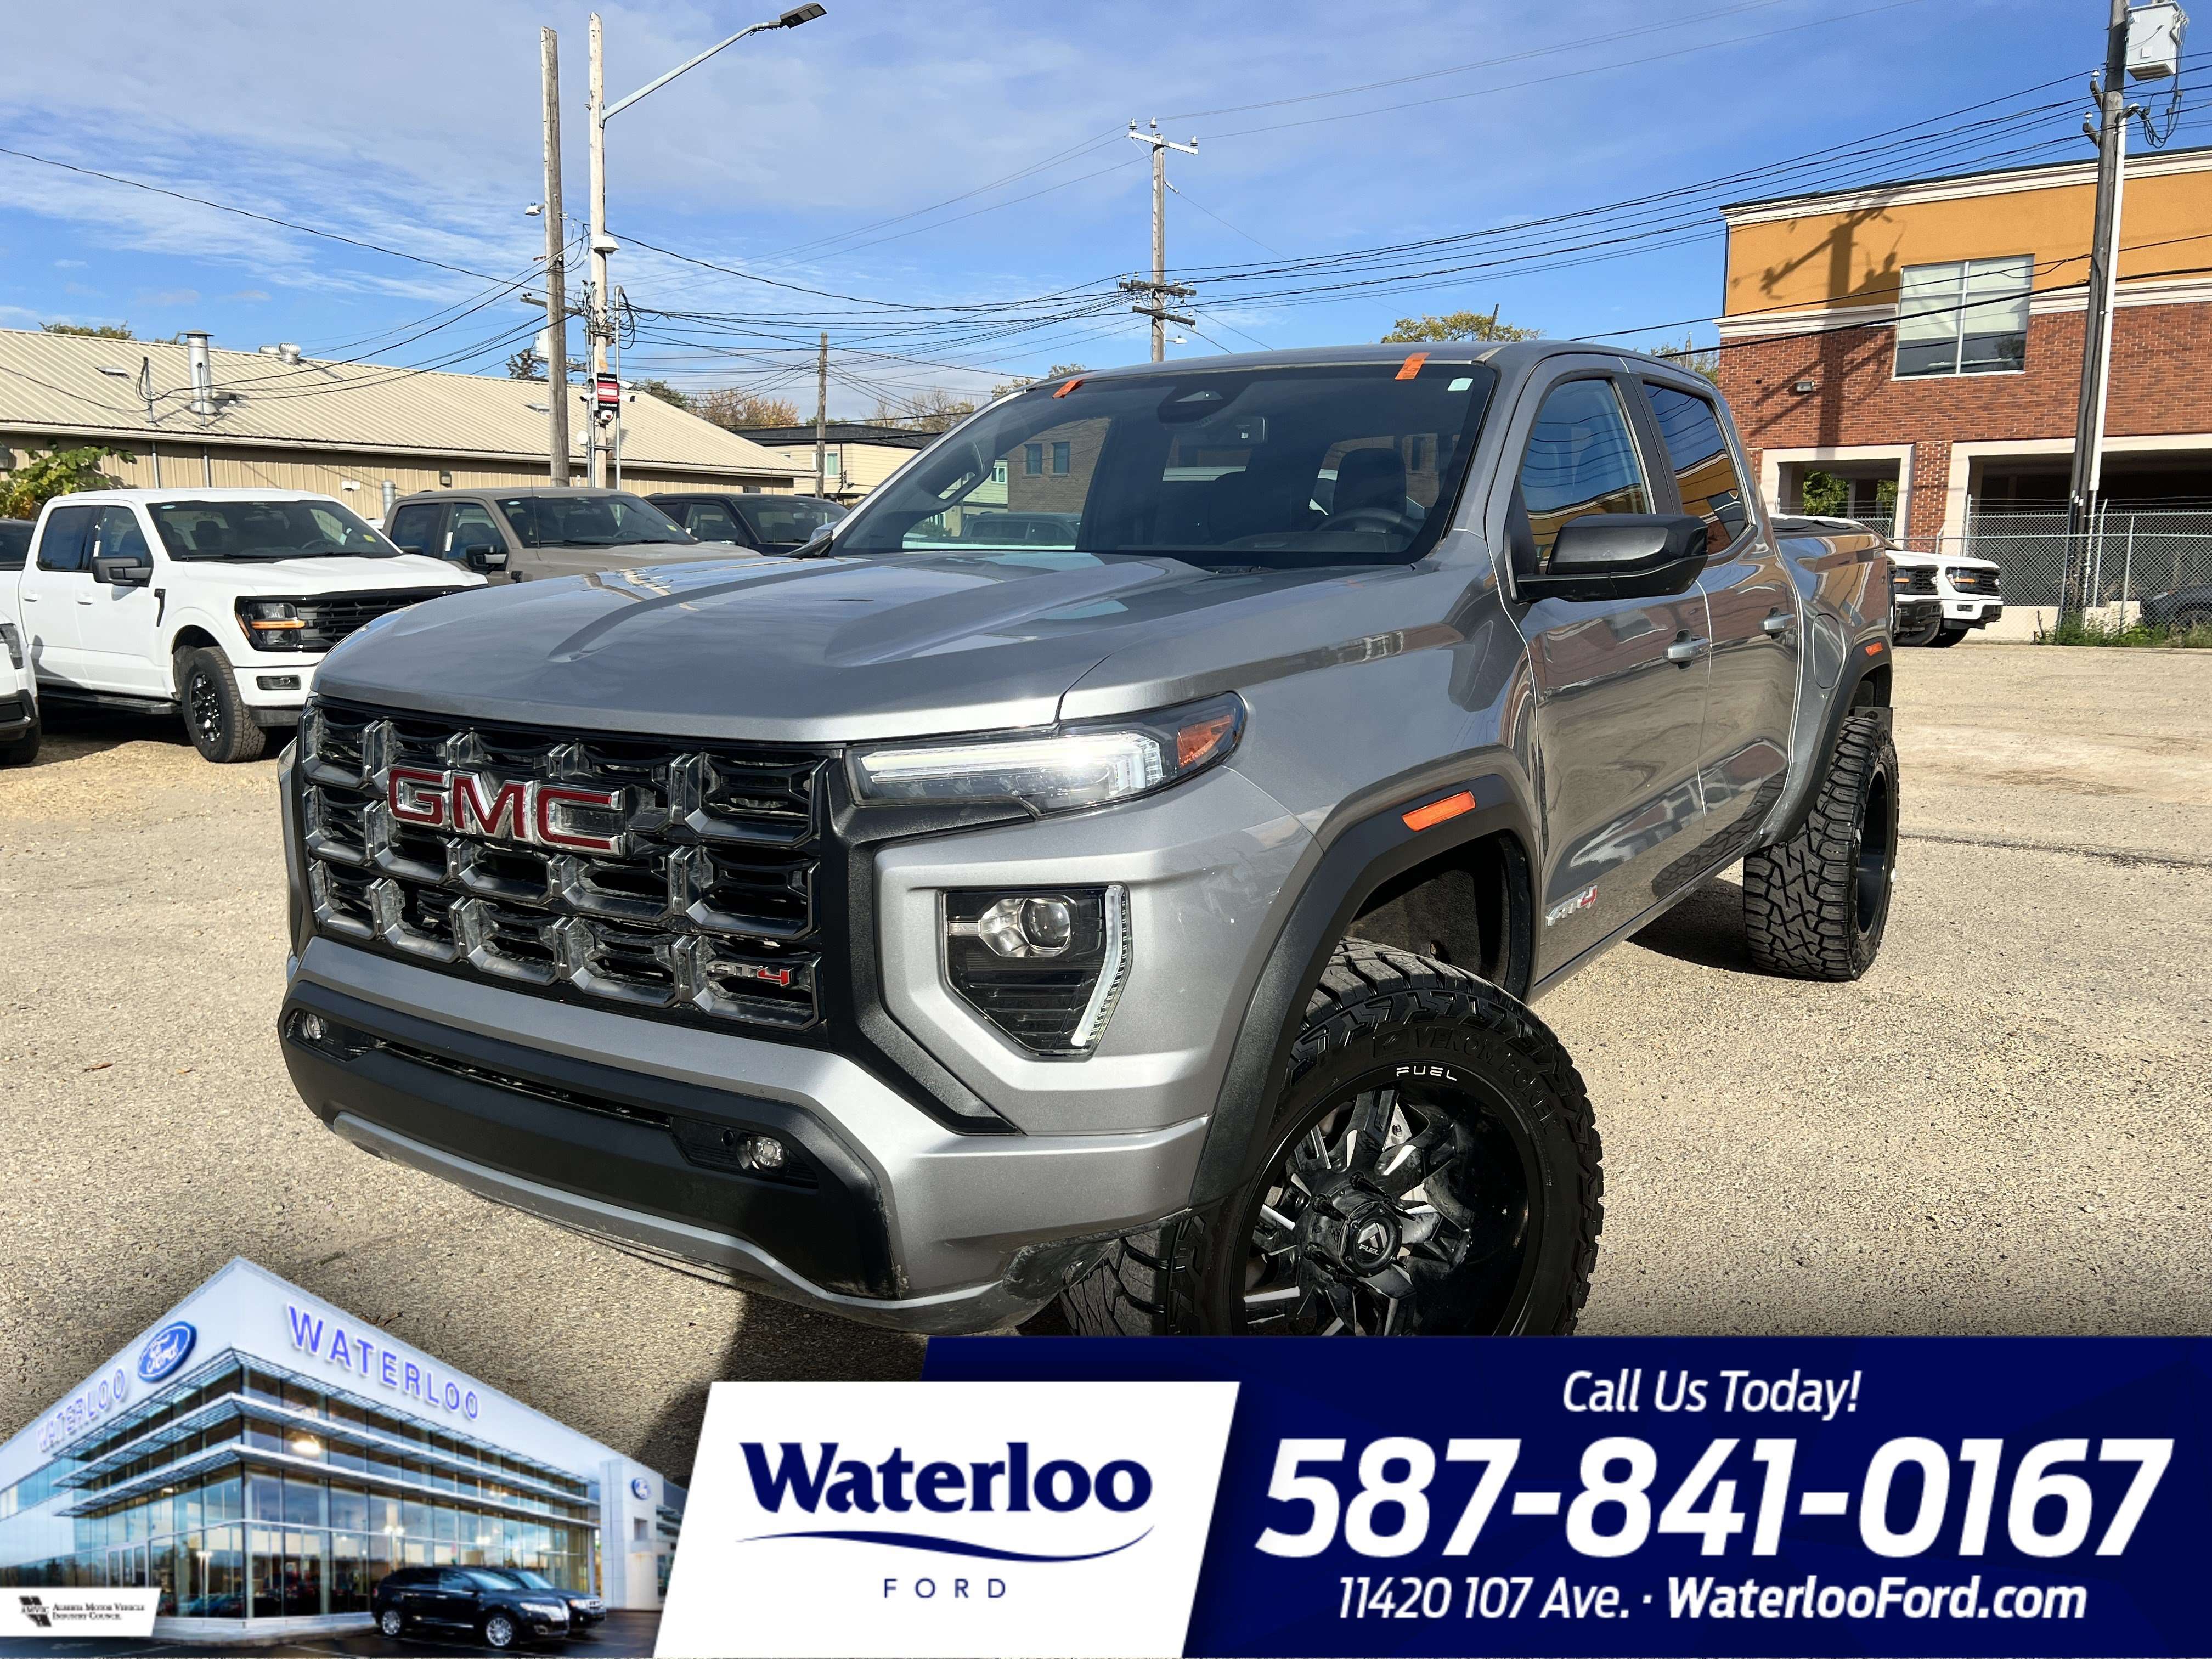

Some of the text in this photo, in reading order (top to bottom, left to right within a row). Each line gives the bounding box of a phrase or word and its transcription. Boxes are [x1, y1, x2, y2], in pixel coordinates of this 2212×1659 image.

[387, 768, 624, 856] GMC
[706, 960, 791, 987] AT4
[1396, 1065, 1458, 1082] FUEL
[1415, 1026, 1558, 1135] VENOM POWER
[1358, 1243, 1379, 1256] FUEL
